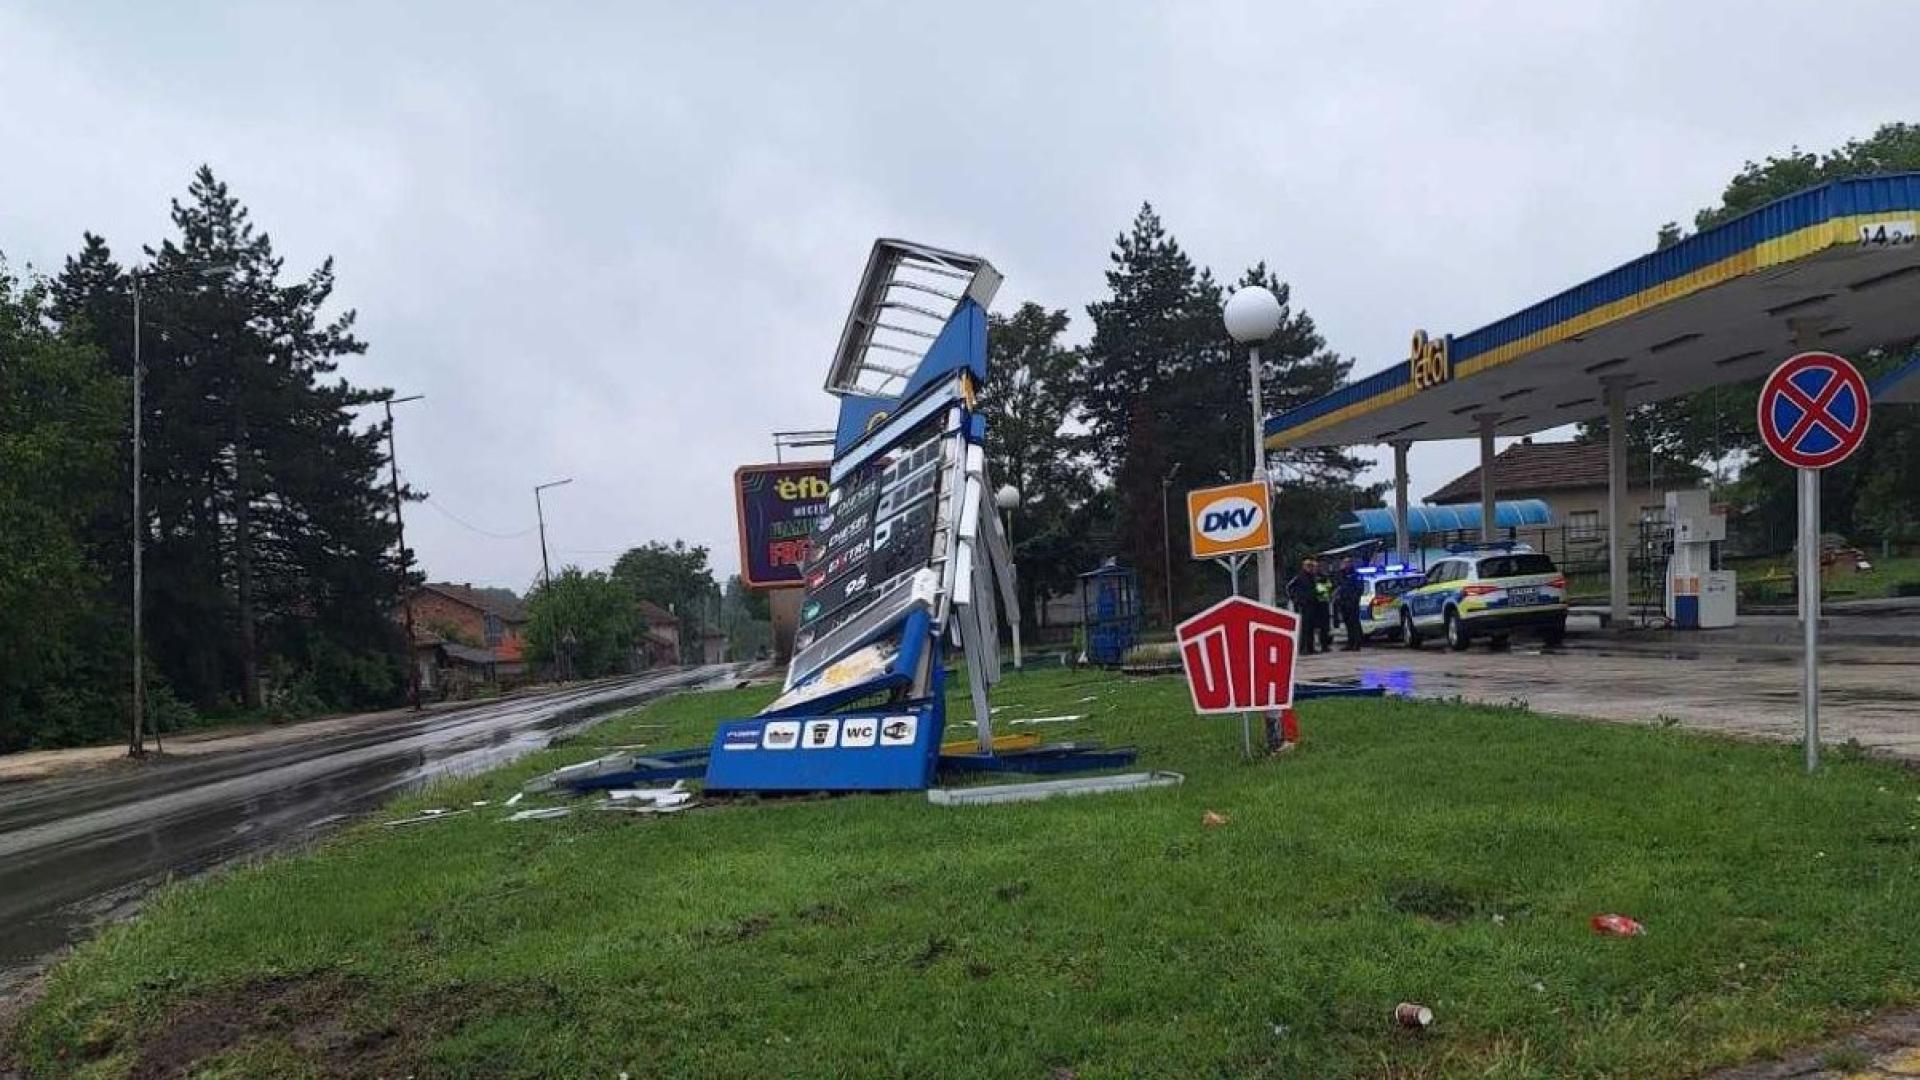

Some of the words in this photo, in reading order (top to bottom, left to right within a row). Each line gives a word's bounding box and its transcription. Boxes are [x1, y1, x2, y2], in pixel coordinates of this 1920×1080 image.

[778, 475, 829, 500] efb
[1202, 506, 1258, 533] DKV
[845, 573, 868, 597] 95
[1179, 600, 1297, 710] UTA
[847, 726, 873, 738] WC
